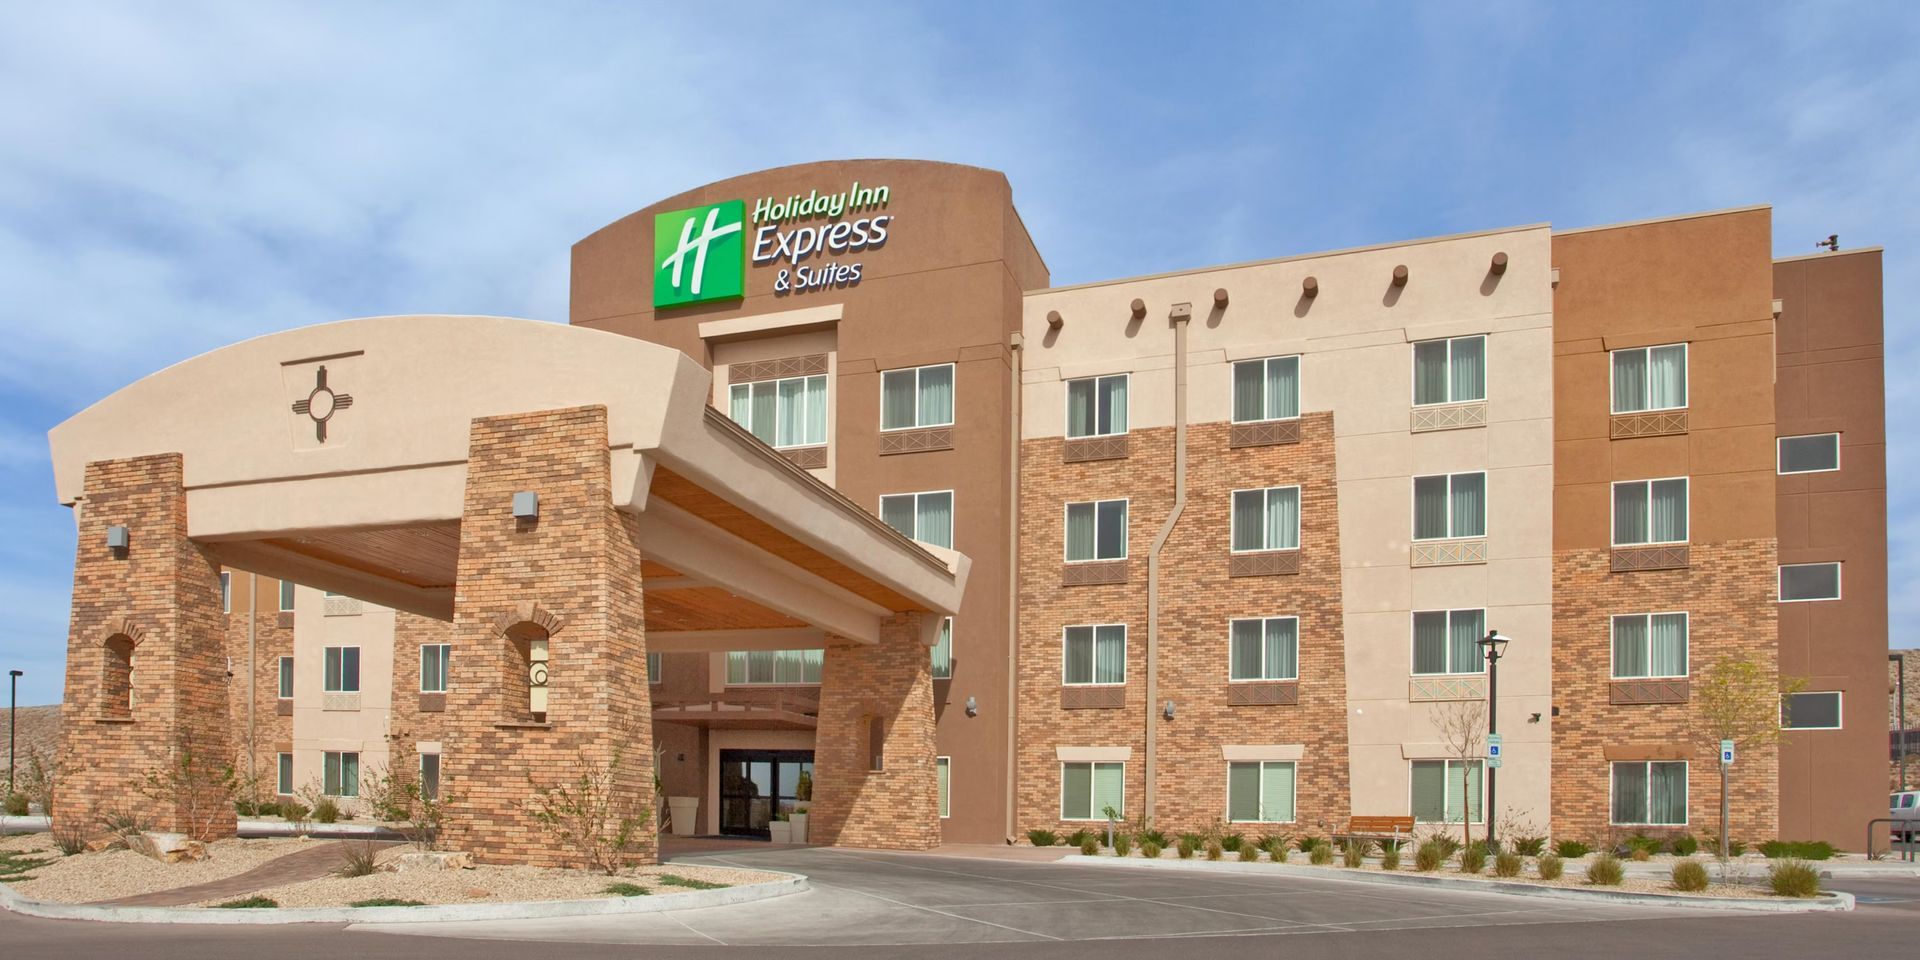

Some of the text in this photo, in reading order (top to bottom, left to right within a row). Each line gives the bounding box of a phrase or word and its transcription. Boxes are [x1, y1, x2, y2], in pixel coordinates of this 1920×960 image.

[752, 181, 890, 224] Holiday Inn
[752, 215, 890, 265] Express
[774, 262, 862, 291] & Suites
